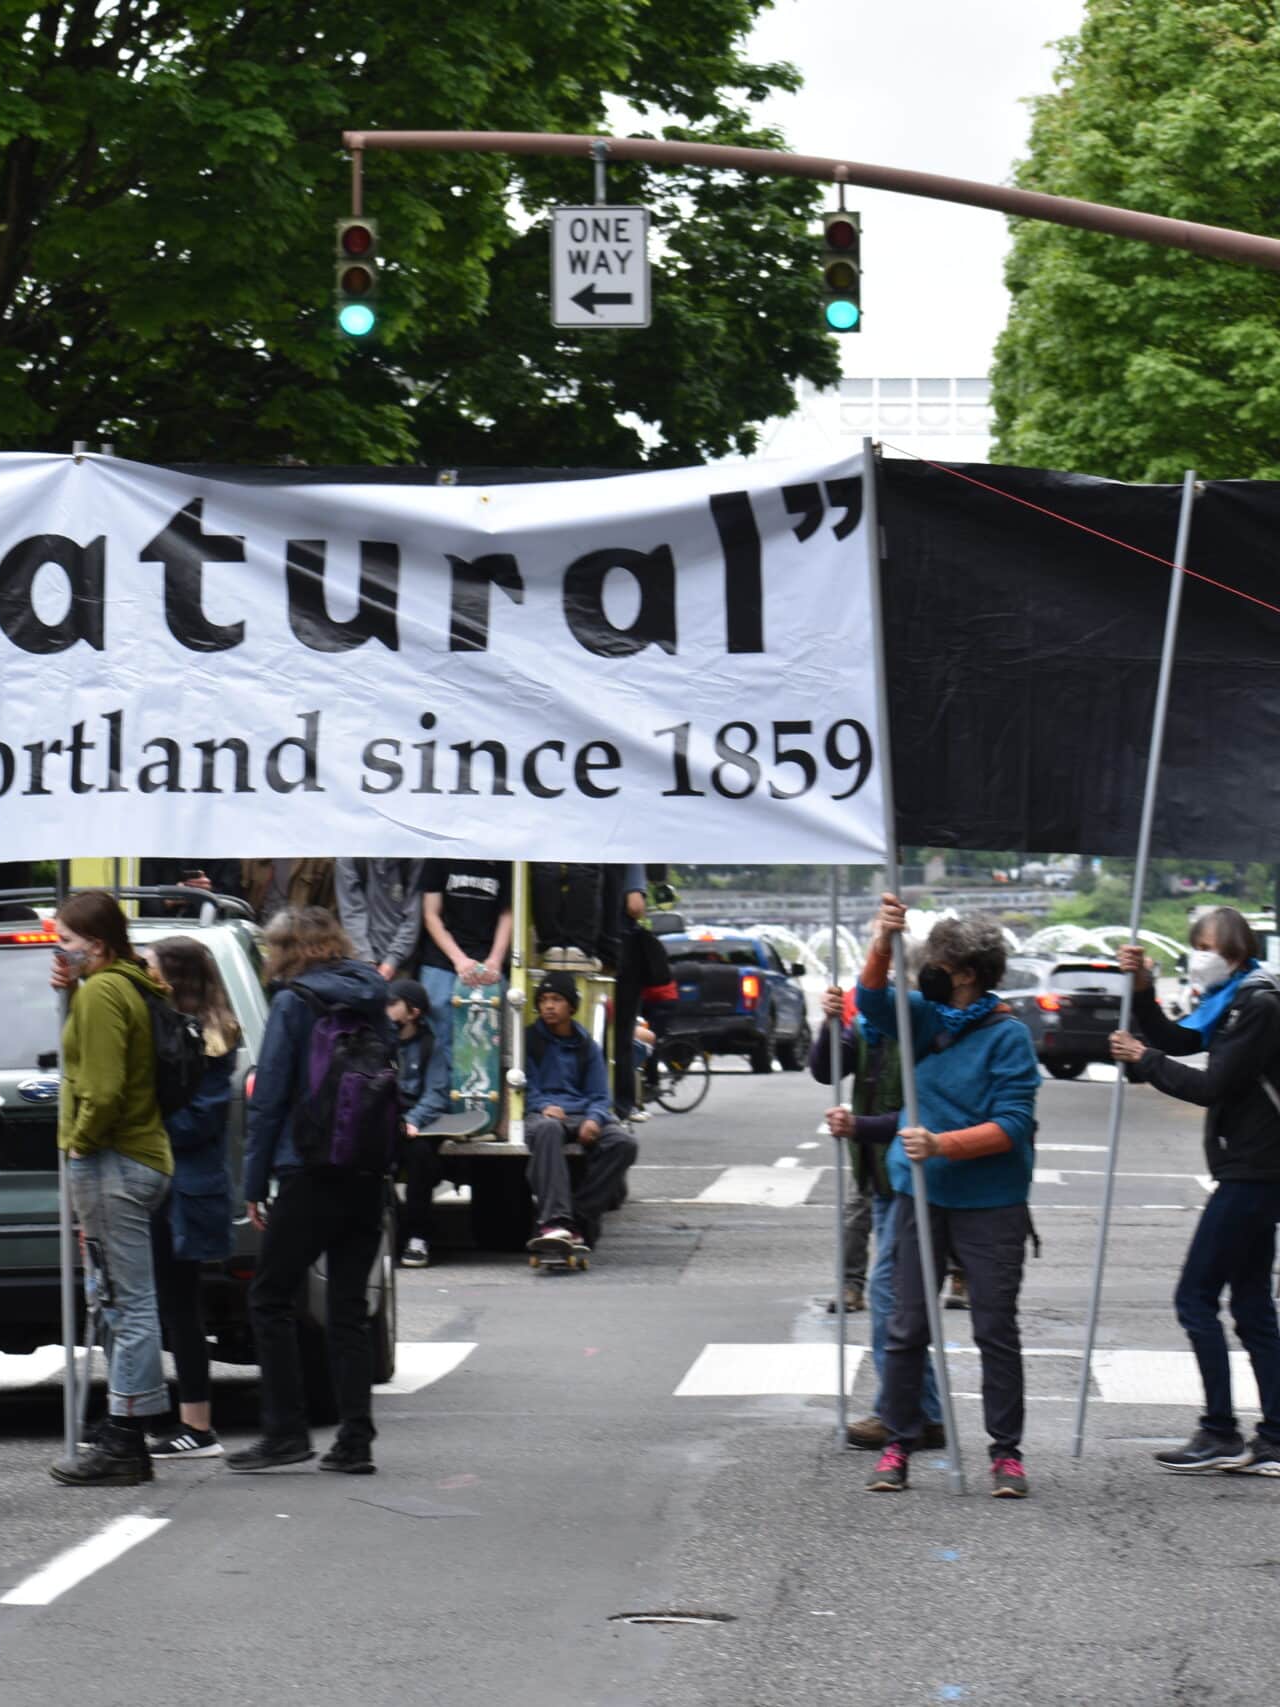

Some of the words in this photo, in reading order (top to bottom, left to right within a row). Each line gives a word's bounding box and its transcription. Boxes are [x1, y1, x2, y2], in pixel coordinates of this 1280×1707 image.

[569, 217, 632, 244] ONE
[568, 249, 634, 275] WAY
[360, 711, 623, 798] since
[654, 718, 874, 800] 1859
